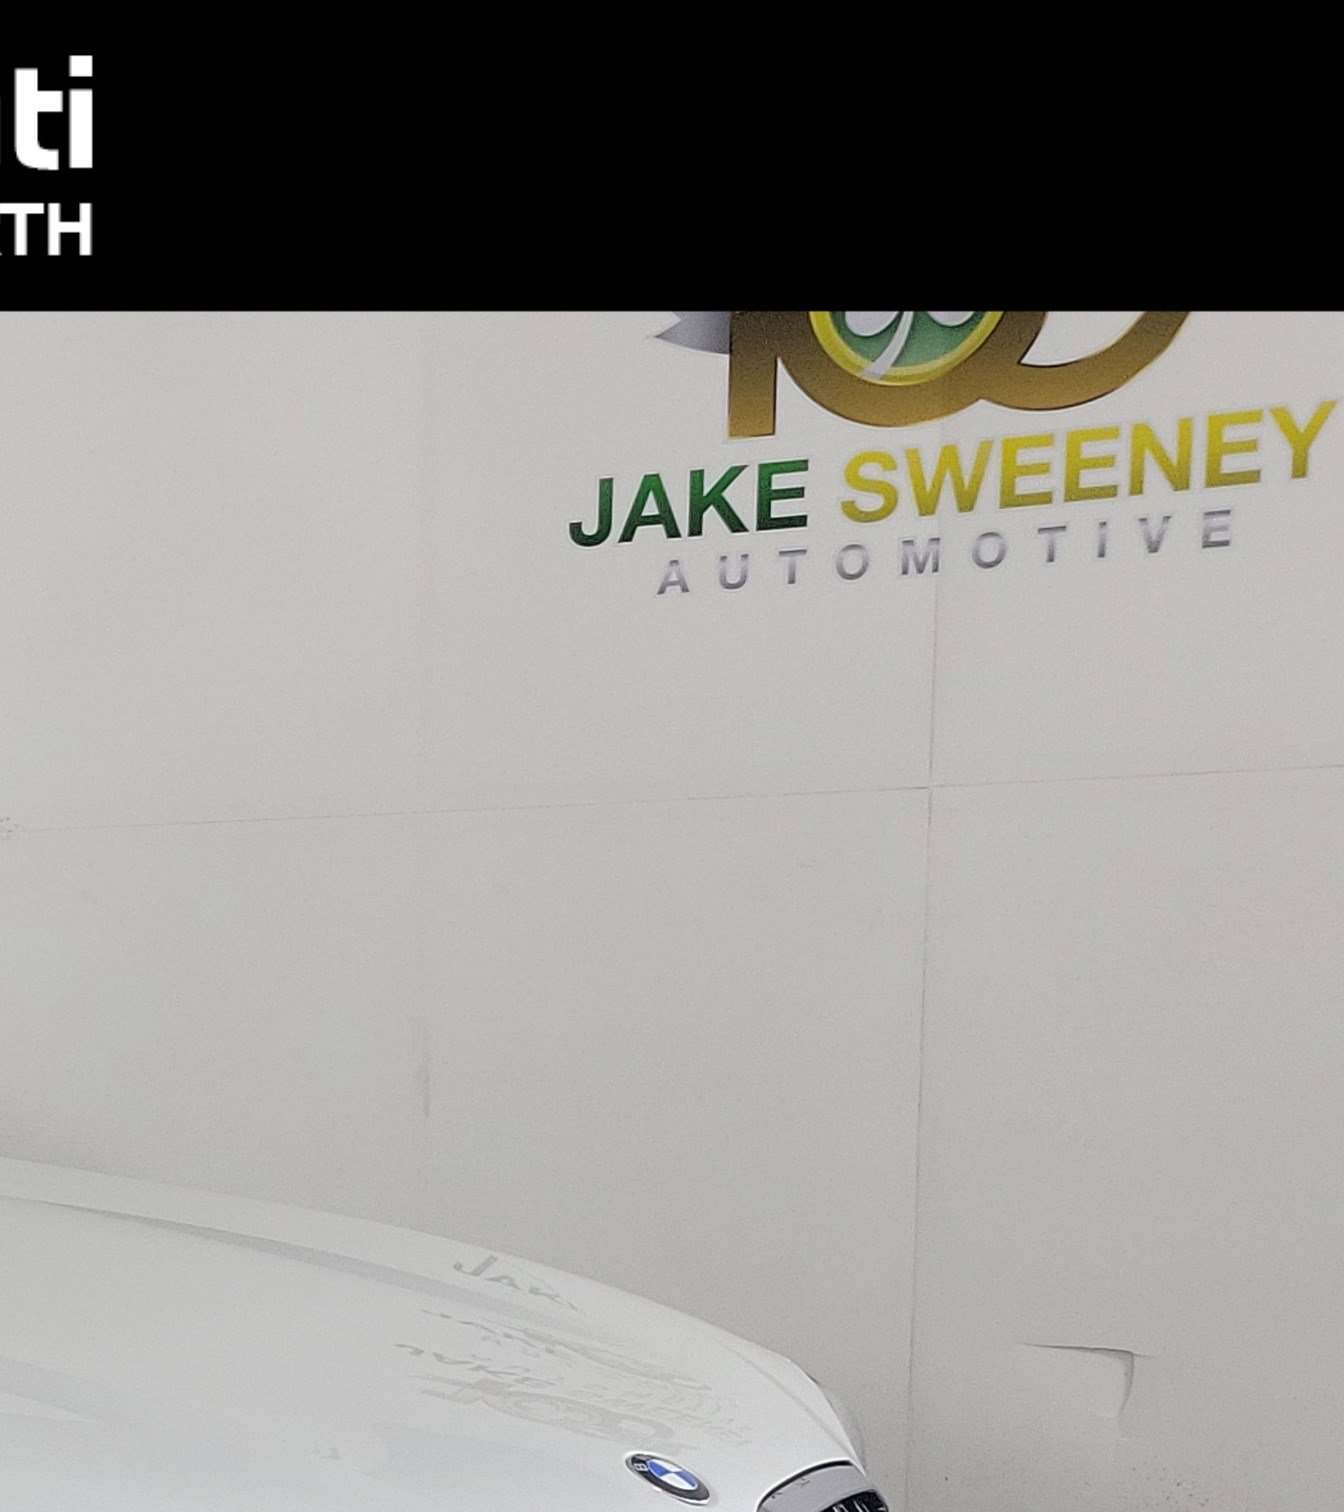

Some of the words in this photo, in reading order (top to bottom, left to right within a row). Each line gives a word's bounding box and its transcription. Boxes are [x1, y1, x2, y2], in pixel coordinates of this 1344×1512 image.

[568, 457, 810, 548] JAKE
[839, 399, 1338, 524] SWEENEY
[656, 508, 1234, 597] AUTOMOTIVE
